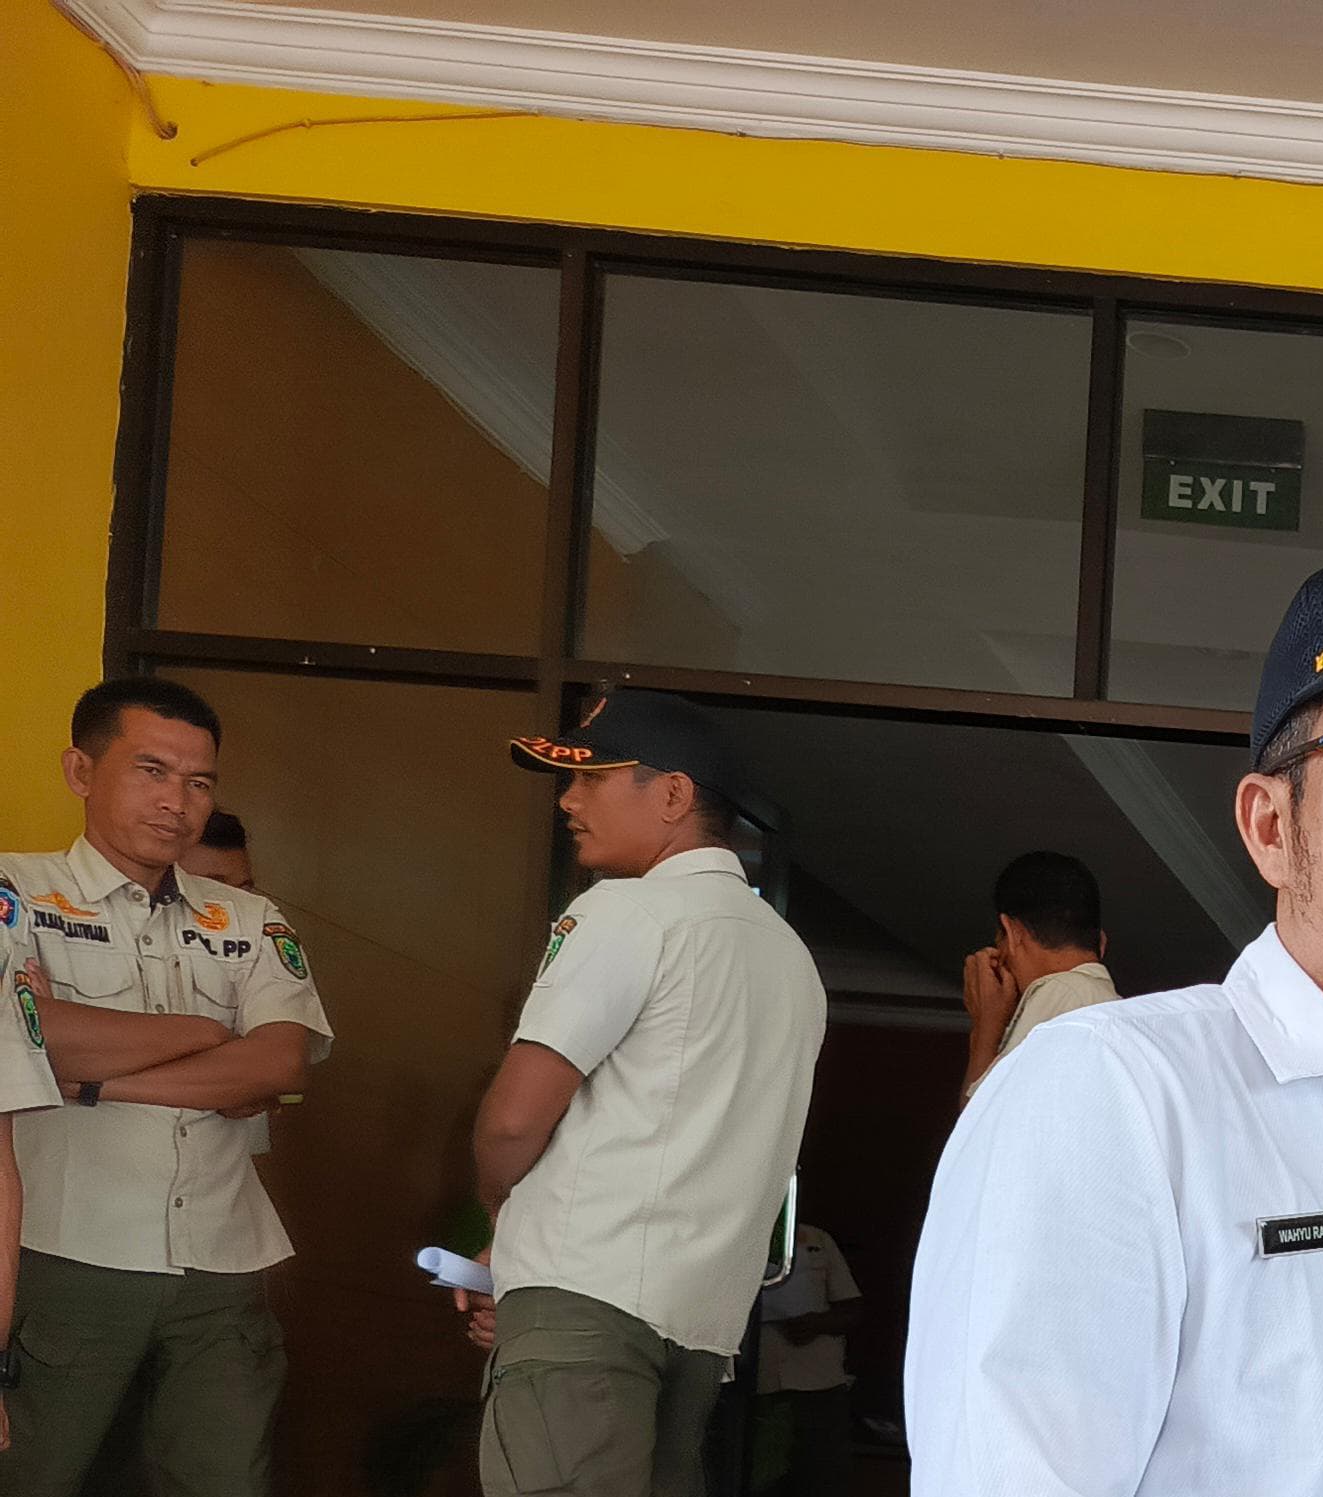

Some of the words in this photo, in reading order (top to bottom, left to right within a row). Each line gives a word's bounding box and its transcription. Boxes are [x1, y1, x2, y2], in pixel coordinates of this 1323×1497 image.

[1168, 474, 1276, 515] EXIT
[551, 746, 593, 761] PP
[182, 929, 218, 956] PL
[223, 940, 251, 958] PP
[1279, 1226, 1312, 1243] WAHYU
